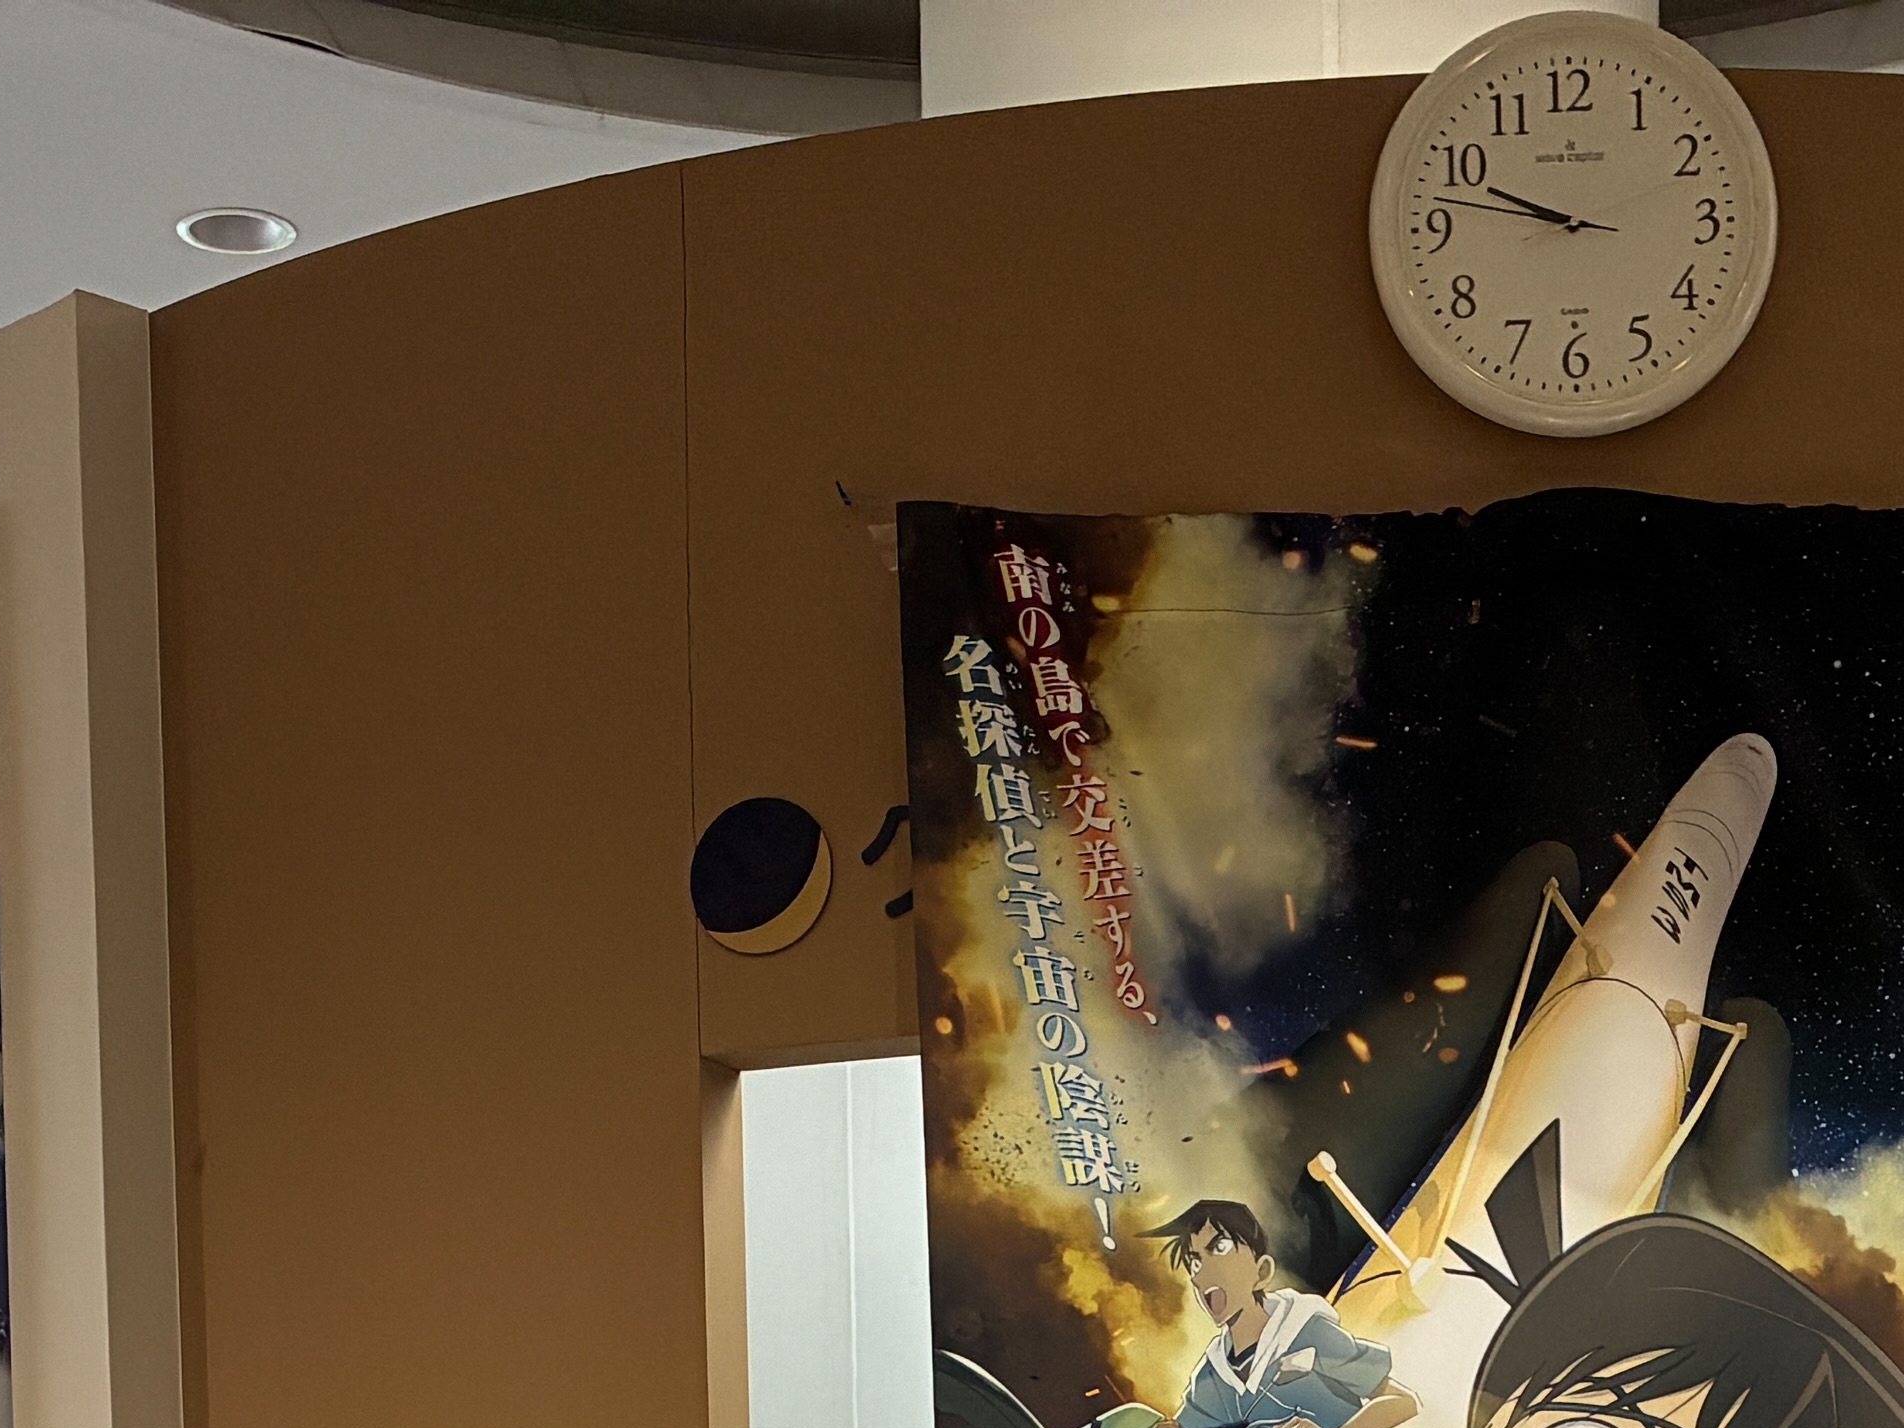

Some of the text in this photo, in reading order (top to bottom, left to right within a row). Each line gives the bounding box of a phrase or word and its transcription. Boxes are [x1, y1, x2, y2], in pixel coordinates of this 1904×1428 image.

[1546, 68, 1594, 113] 12
[1629, 88, 1648, 131] 1
[1490, 93, 1530, 136] 11
[1442, 143, 1487, 187] 10
[1673, 134, 1702, 177] 2
[1426, 209, 1452, 254] 9
[1694, 199, 1720, 245] 3
[1450, 274, 1477, 319] 8
[1670, 264, 1700, 311] 4
[1504, 319, 1532, 365] 7
[1562, 332, 1590, 379] 6
[1628, 314, 1653, 362] 5
[994, 542, 1159, 1027] 南の島で交差する、
